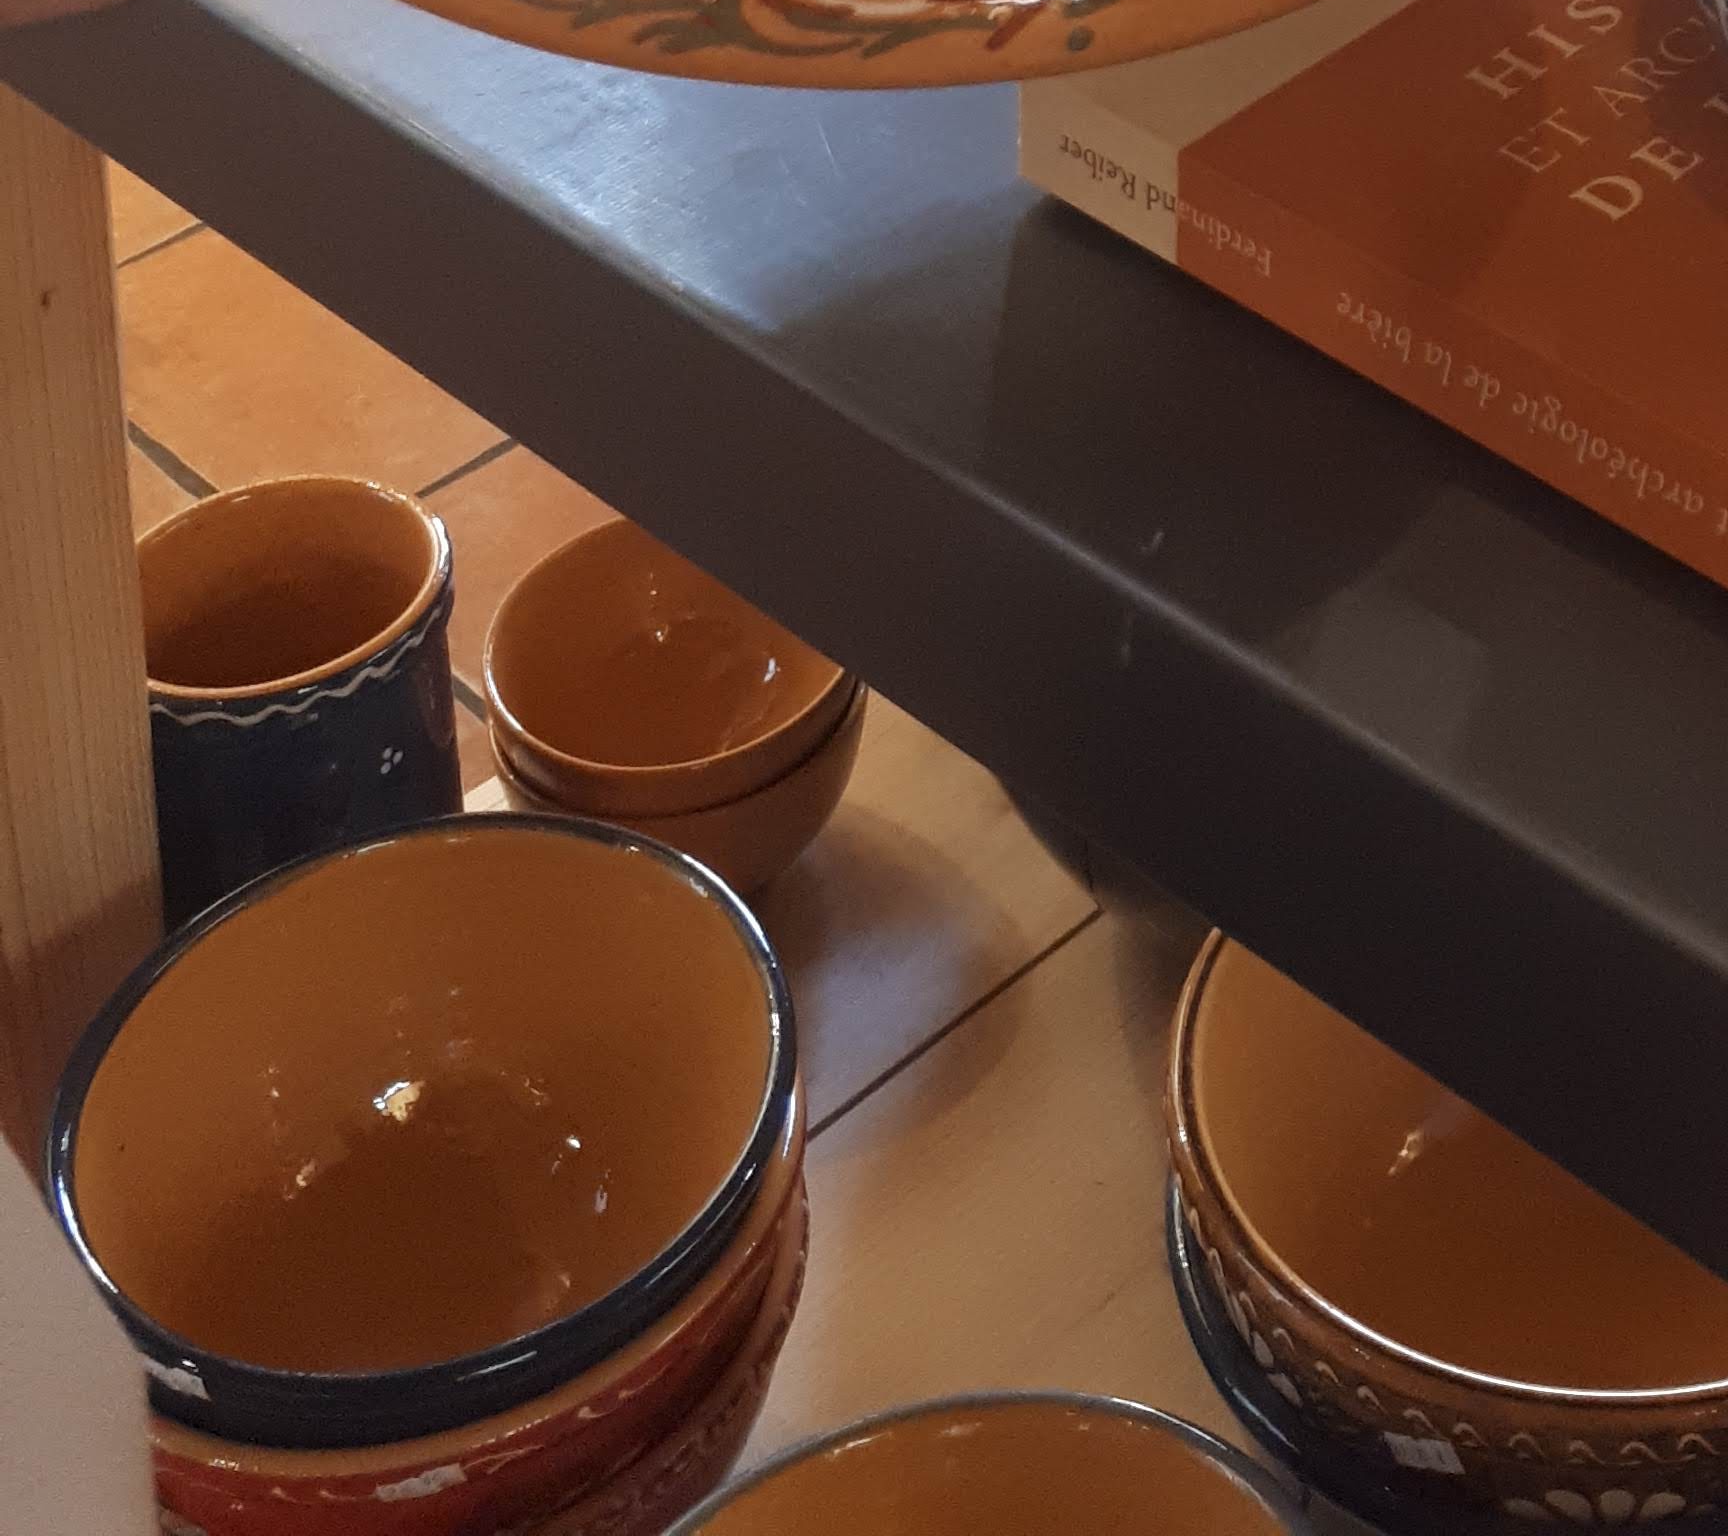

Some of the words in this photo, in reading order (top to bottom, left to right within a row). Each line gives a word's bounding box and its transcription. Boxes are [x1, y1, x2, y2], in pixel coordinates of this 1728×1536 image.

[1060, 134, 1137, 201] Reiber
[1499, 107, 1591, 174] ET
[1569, 136, 1705, 222] DE
[1145, 181, 1272, 276] Ferdinand
[1337, 292, 1412, 362] bière
[1426, 341, 1452, 375] la
[1463, 365, 1500, 398] de
[1511, 392, 1704, 512] archéologie
